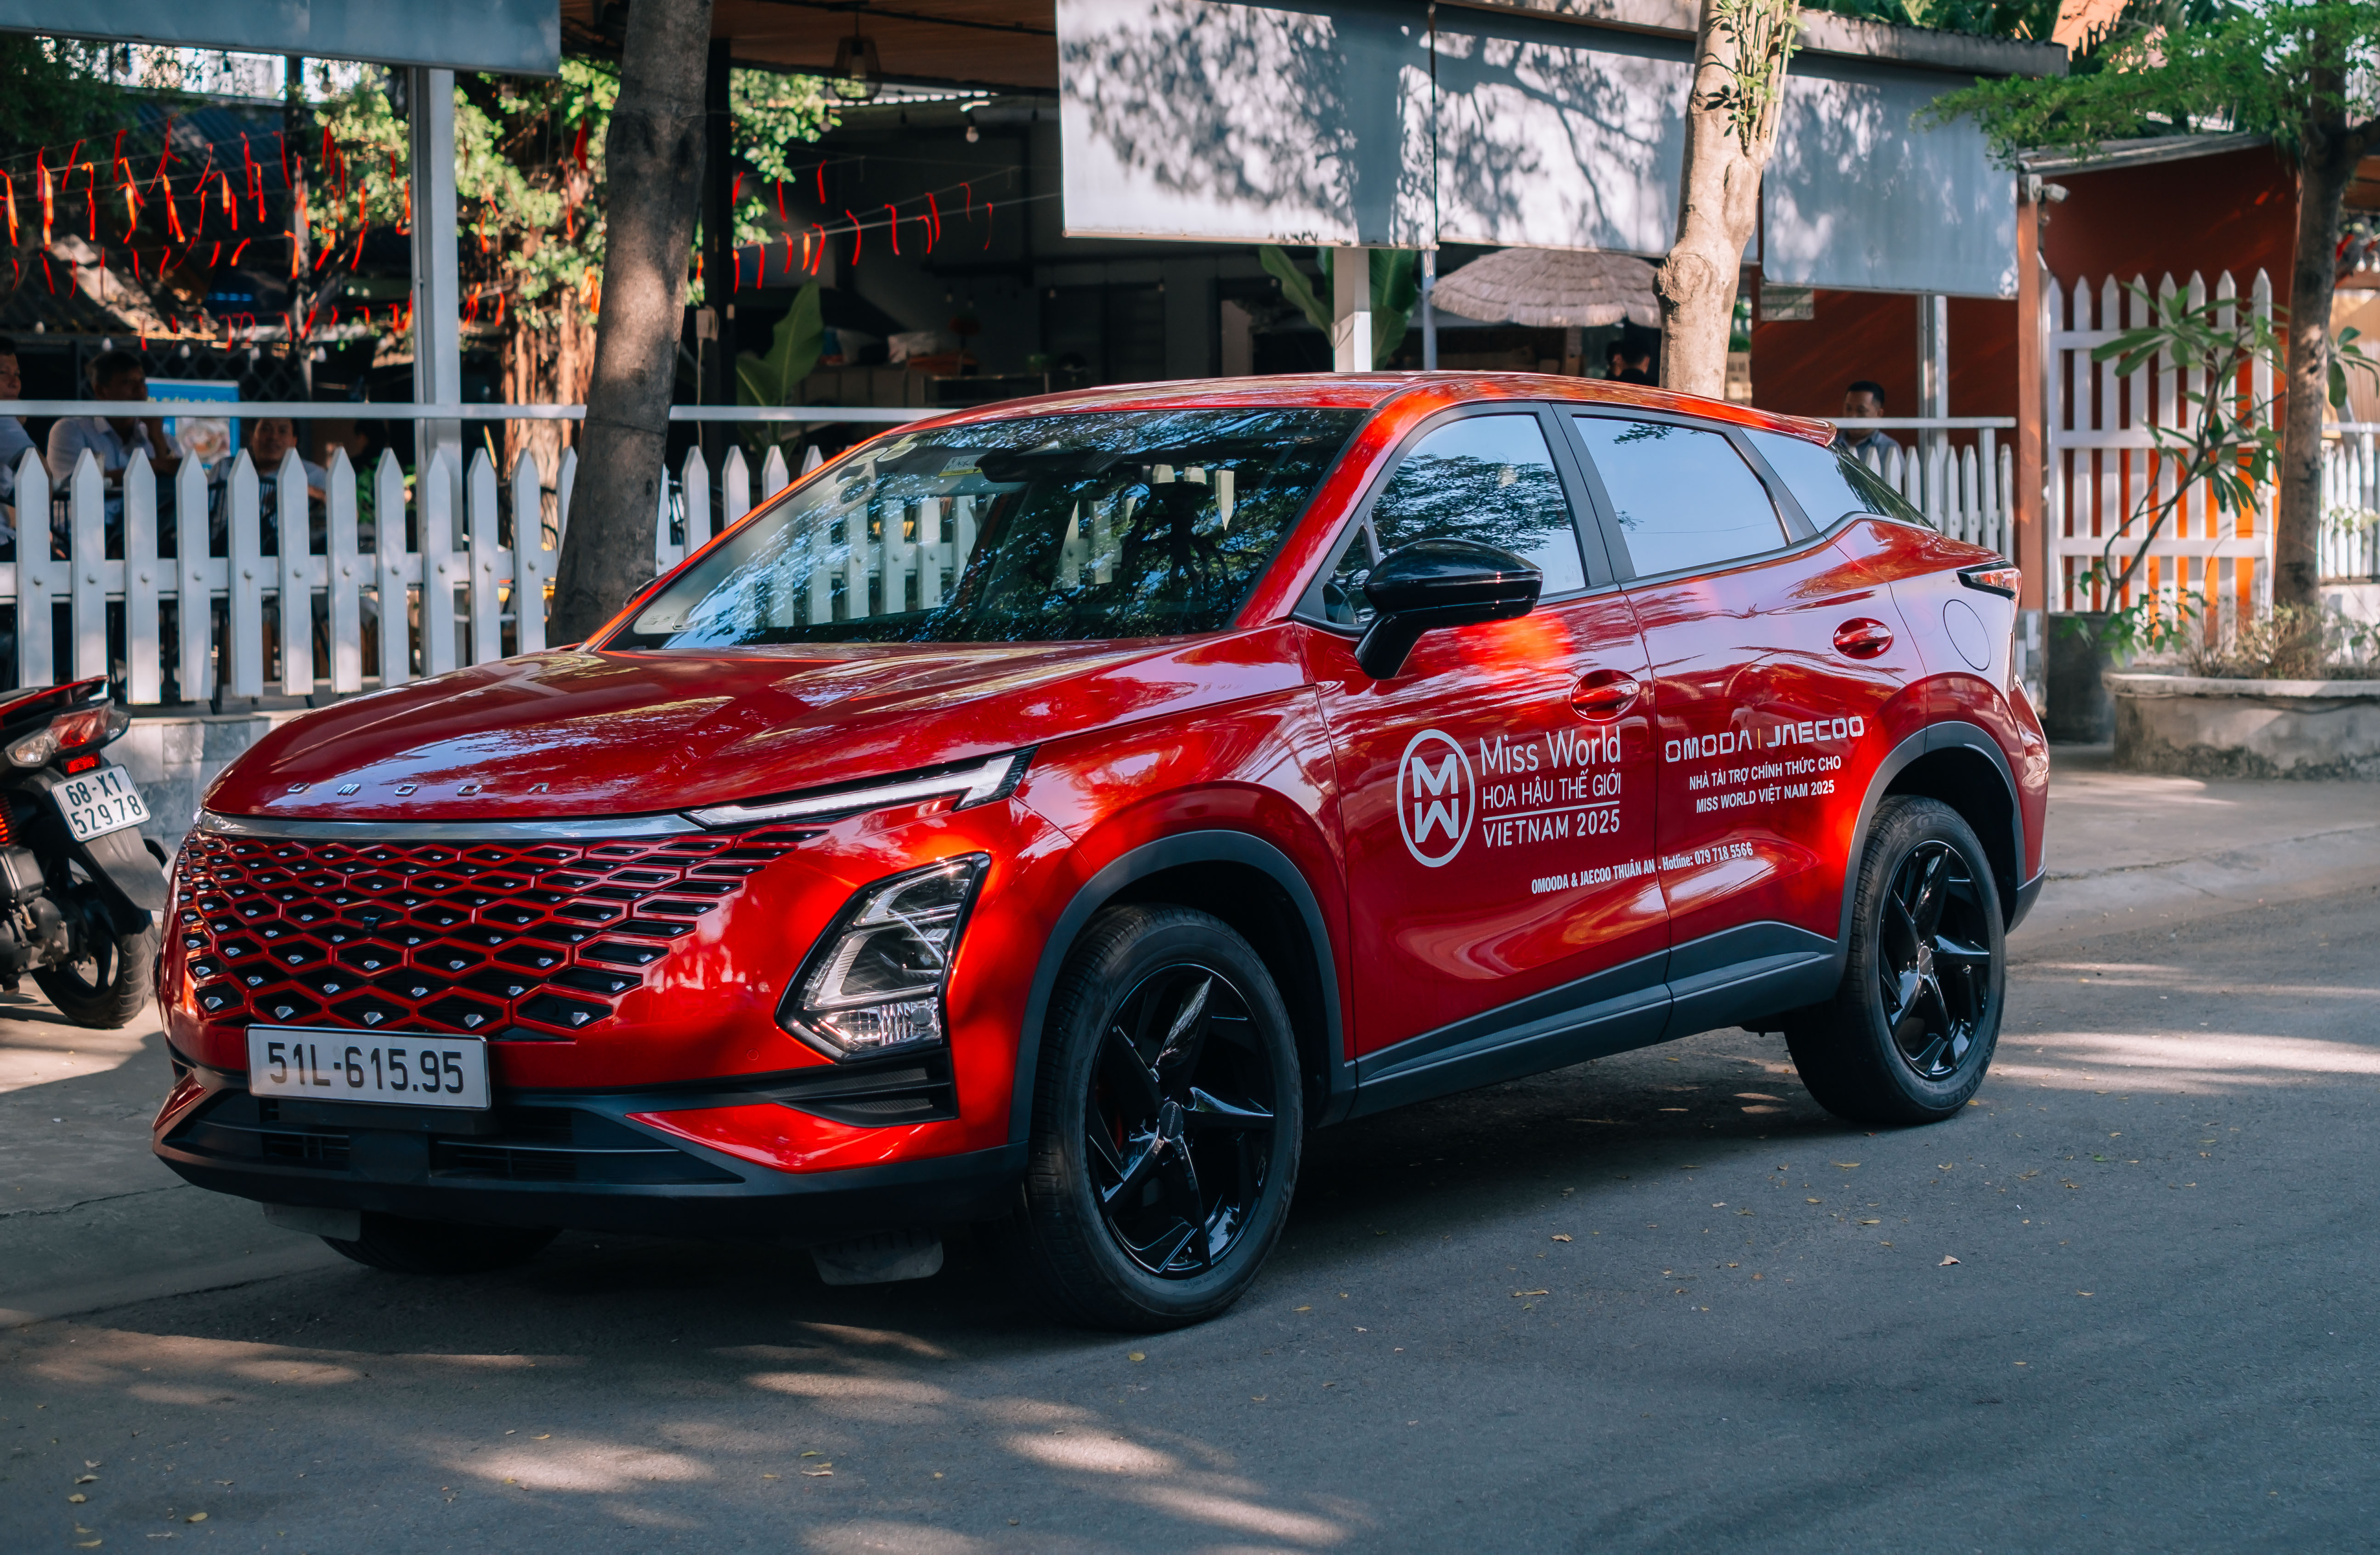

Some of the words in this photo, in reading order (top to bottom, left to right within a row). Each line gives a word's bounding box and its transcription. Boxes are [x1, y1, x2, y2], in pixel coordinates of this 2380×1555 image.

[1480, 734, 1538, 776] Miss
[1546, 725, 1621, 769] World
[1665, 730, 1752, 762] OMODA
[1766, 716, 1864, 747] JAECOO
[66, 772, 122, 807] 68-X1
[287, 782, 550, 797] OMODA
[1483, 784, 1516, 809] HOA
[1522, 776, 1553, 806] HẬU
[1559, 768, 1589, 800] THẾ
[1593, 769, 1621, 797] GIỚI
[1690, 770, 1709, 790] NHÀ
[1711, 768, 1726, 787] TÀI
[1729, 767, 1749, 785] TRỢ
[1751, 761, 1782, 780] CHÍNH
[1785, 757, 1815, 775] THỨC
[1818, 755, 1841, 772] CHO
[70, 795, 142, 835] 529.78
[1696, 797, 1718, 813] MISS
[1720, 790, 1756, 809] WORLD
[1758, 783, 1781, 804] VIỆT
[1784, 783, 1808, 800] NAM
[1810, 779, 1835, 795] 2025
[1483, 814, 1568, 848] VIETNAM
[1577, 809, 1620, 837] 2025
[1532, 873, 1569, 894] OMOODA
[1571, 873, 1578, 887] &
[1580, 866, 1611, 886] JAECOO
[1613, 858, 1642, 880] THUÂN
[1644, 858, 1656, 874] AN
[1662, 853, 1693, 871] Hotline:
[1695, 849, 1711, 865] 079
[1712, 846, 1729, 862] 718
[1730, 841, 1753, 858] 5566
[268, 1041, 464, 1094] 51L-615.95
[1939, 1068, 1981, 1107] SAVERO
